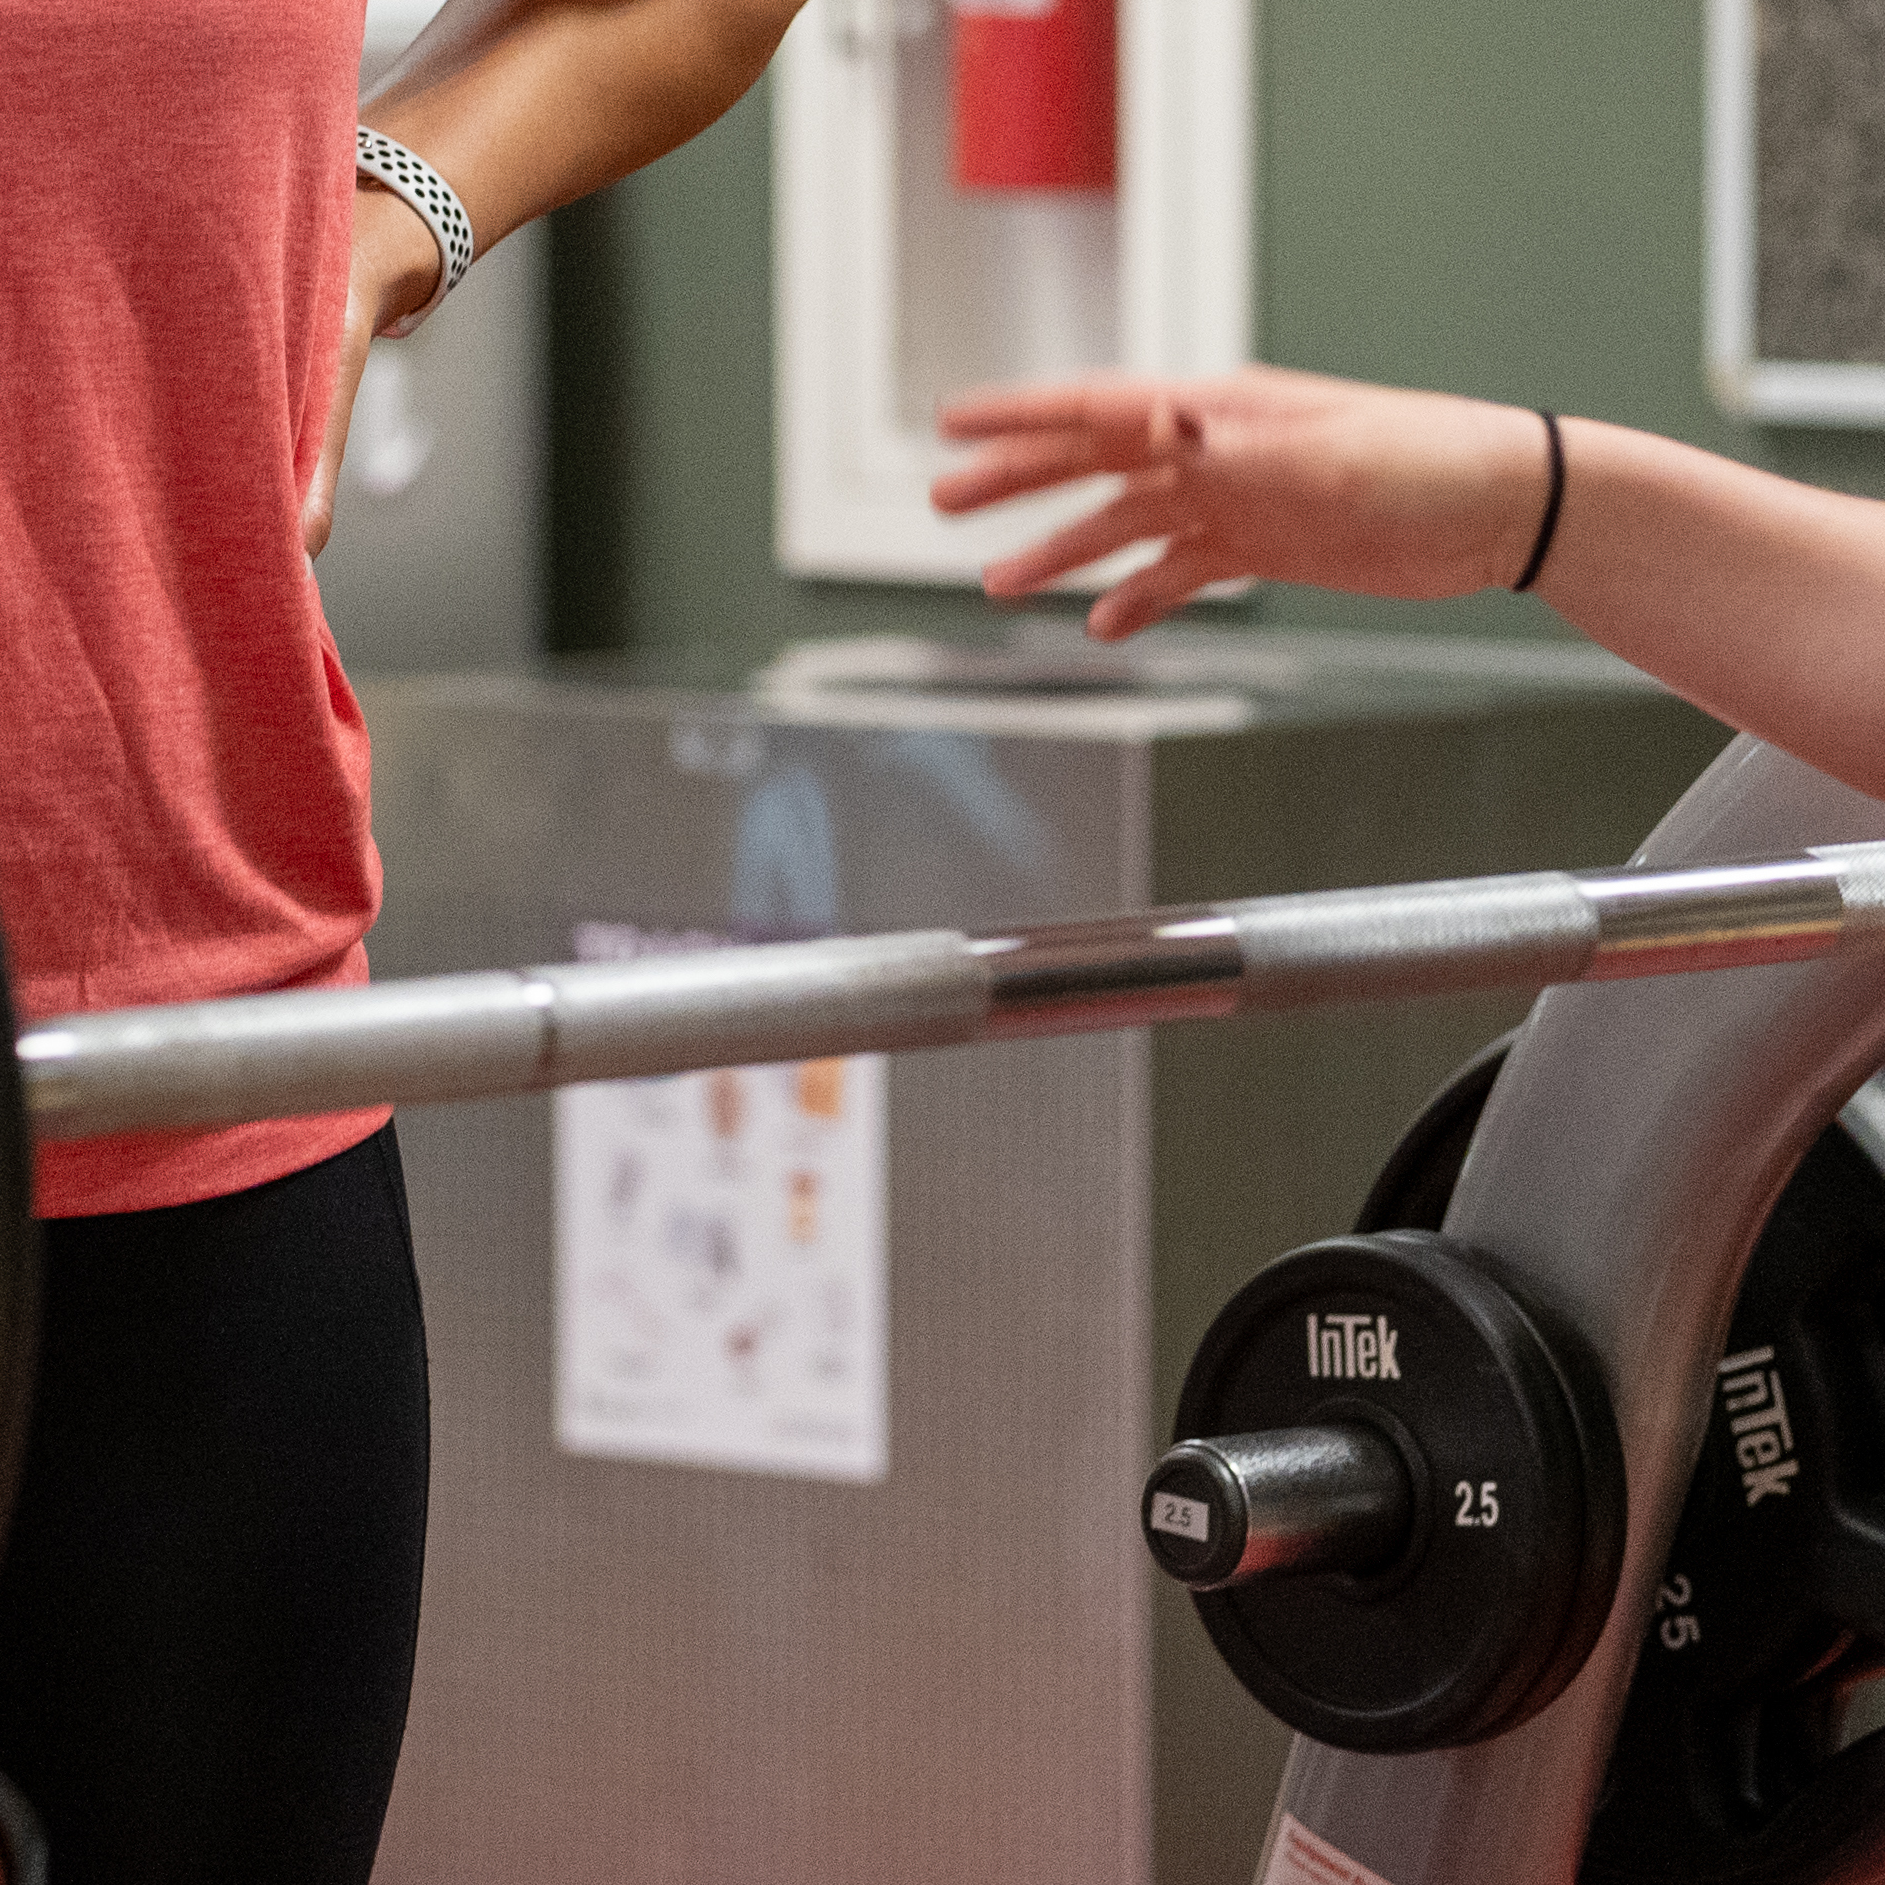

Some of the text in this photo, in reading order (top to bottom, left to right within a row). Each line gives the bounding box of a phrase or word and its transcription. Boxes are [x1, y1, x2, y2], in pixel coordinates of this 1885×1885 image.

[1306, 1313, 1402, 1381] InTek
[1716, 1344, 1800, 1507] InTek
[1454, 1479, 1500, 1527] 2.5
[1656, 1573, 1701, 1651] 25
